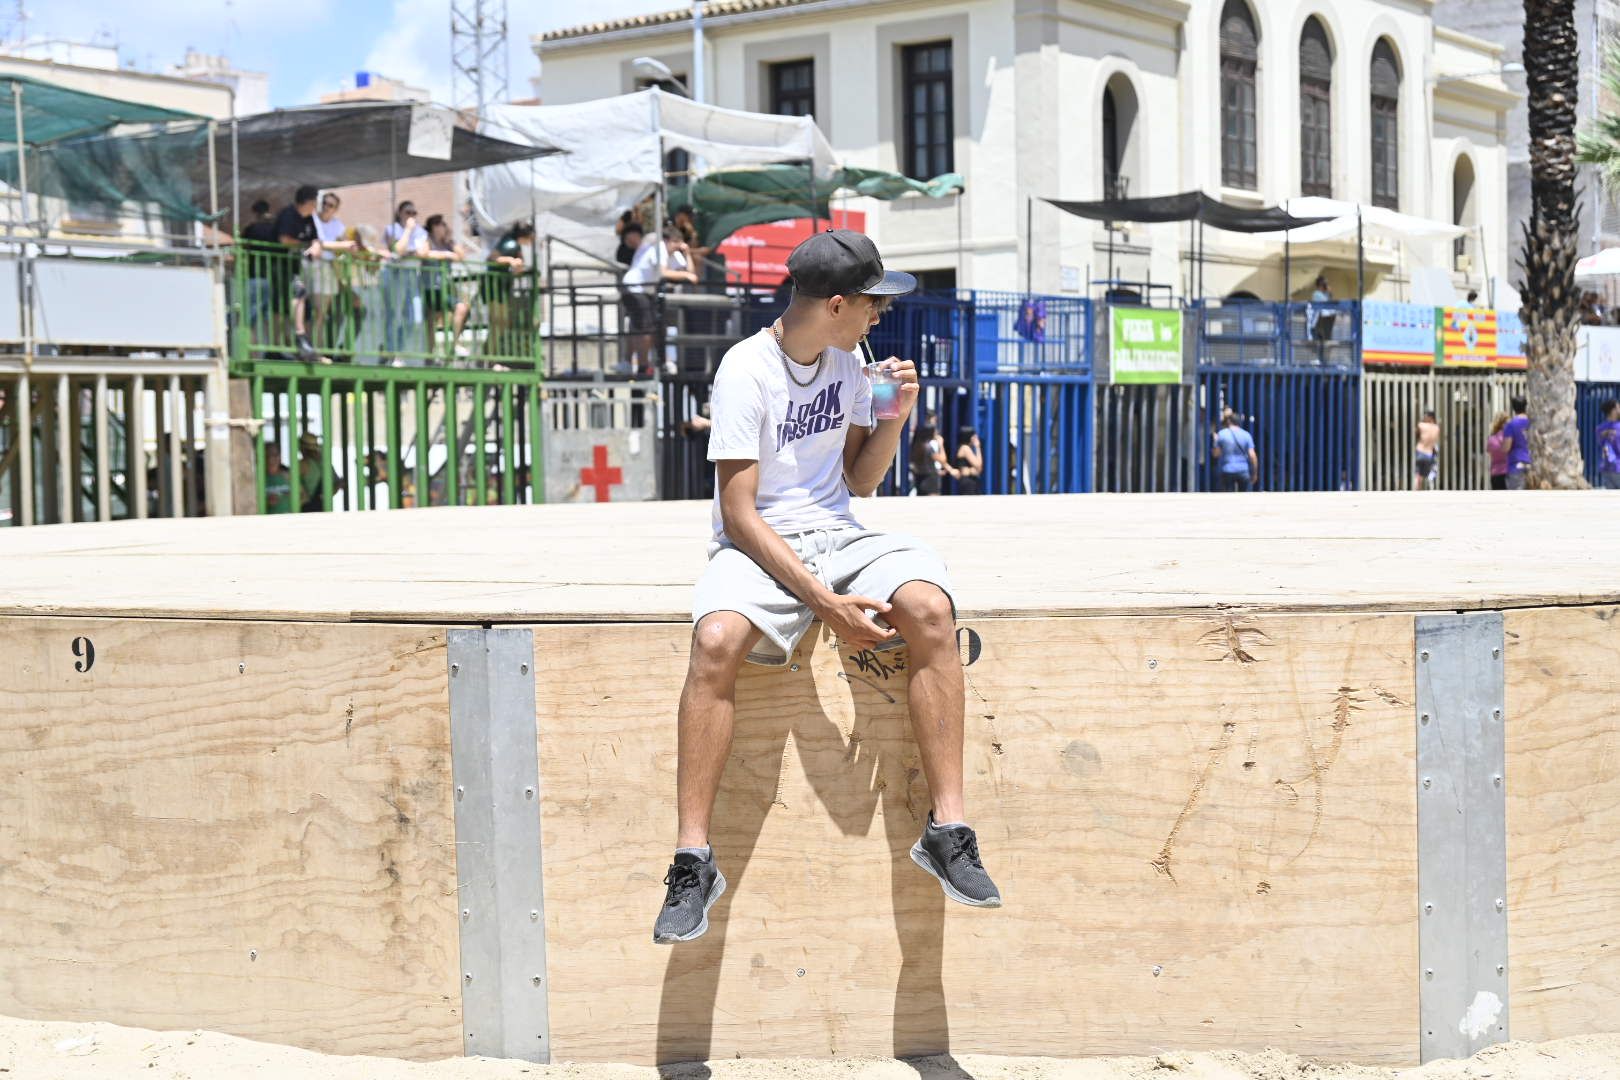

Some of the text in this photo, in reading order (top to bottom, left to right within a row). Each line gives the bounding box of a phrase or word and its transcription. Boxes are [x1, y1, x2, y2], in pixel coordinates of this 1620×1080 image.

[785, 381, 843, 423] LOOK
[776, 413, 845, 452] INSIDE
[71, 636, 95, 673] 9
